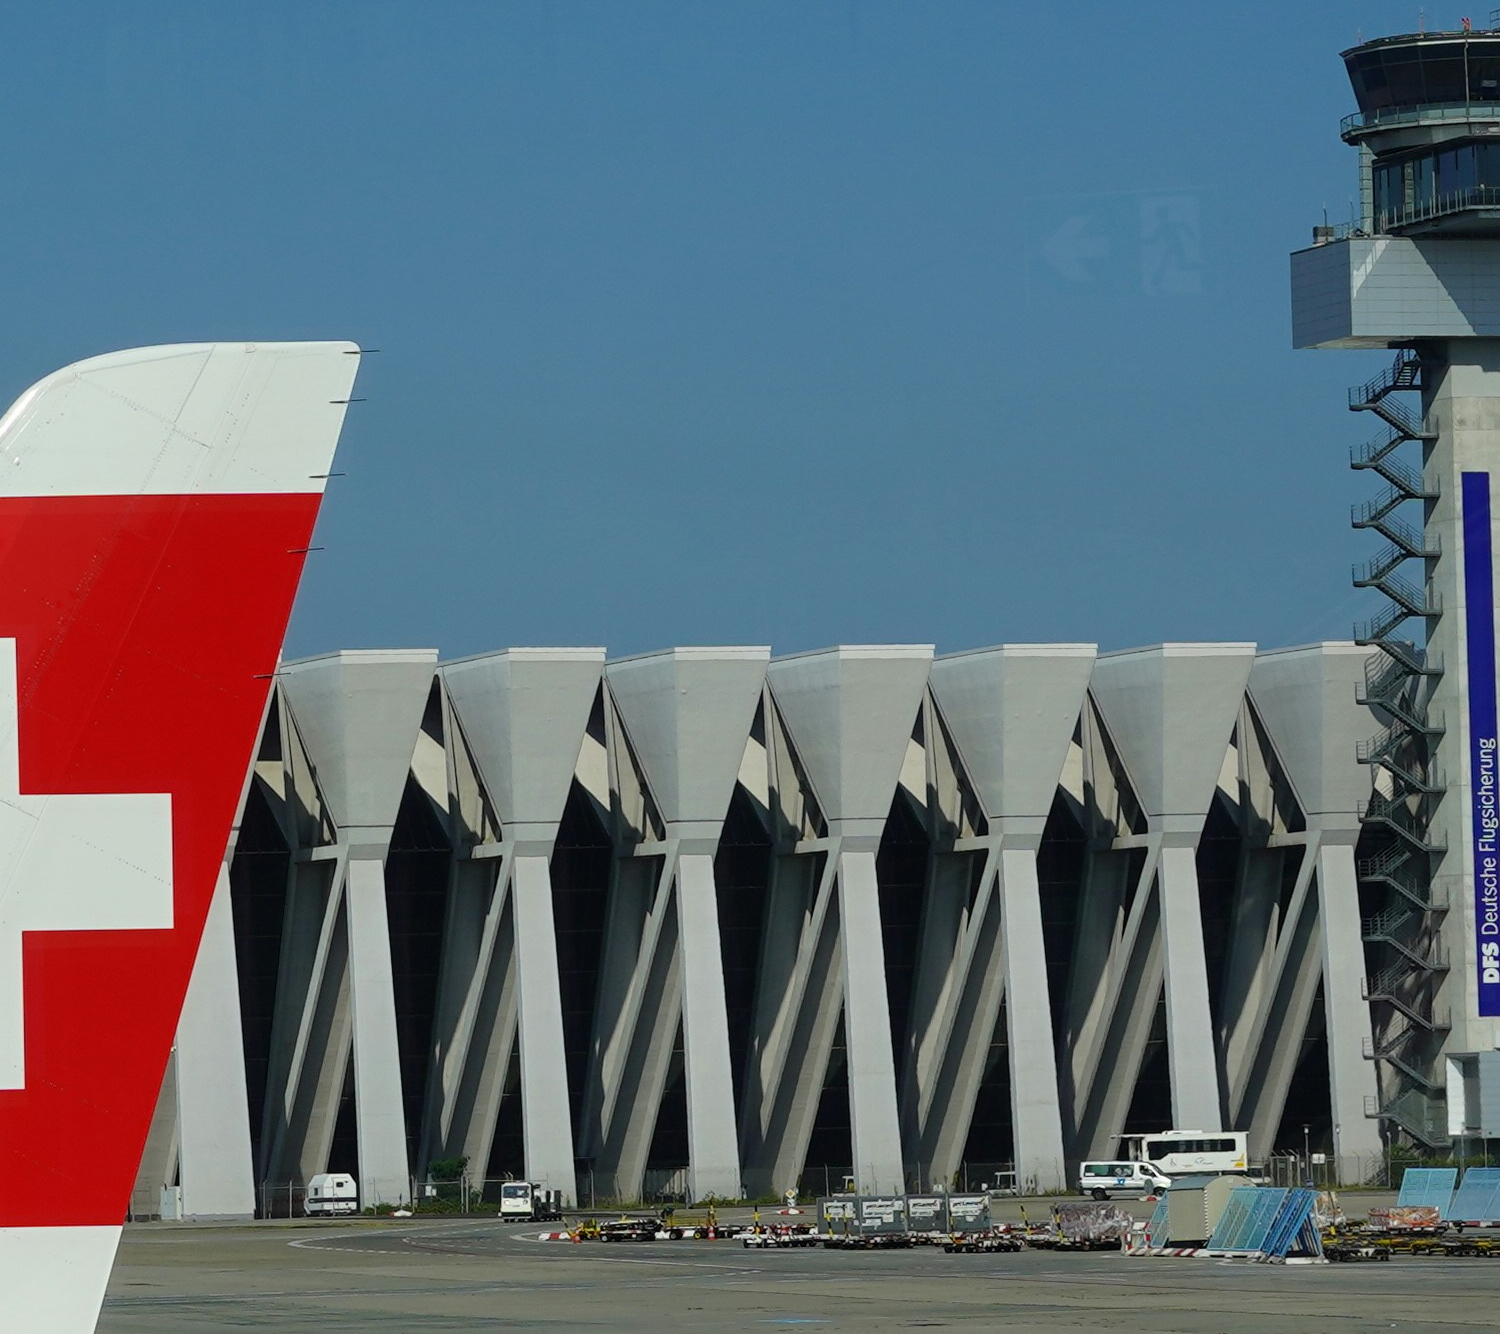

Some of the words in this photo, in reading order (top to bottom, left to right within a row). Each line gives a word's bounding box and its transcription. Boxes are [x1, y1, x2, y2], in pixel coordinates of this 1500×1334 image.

[1477, 738, 1499, 852] Flugsicherung
[1481, 858, 1499, 935] Deutsche
[1481, 941, 1500, 984] DFS
